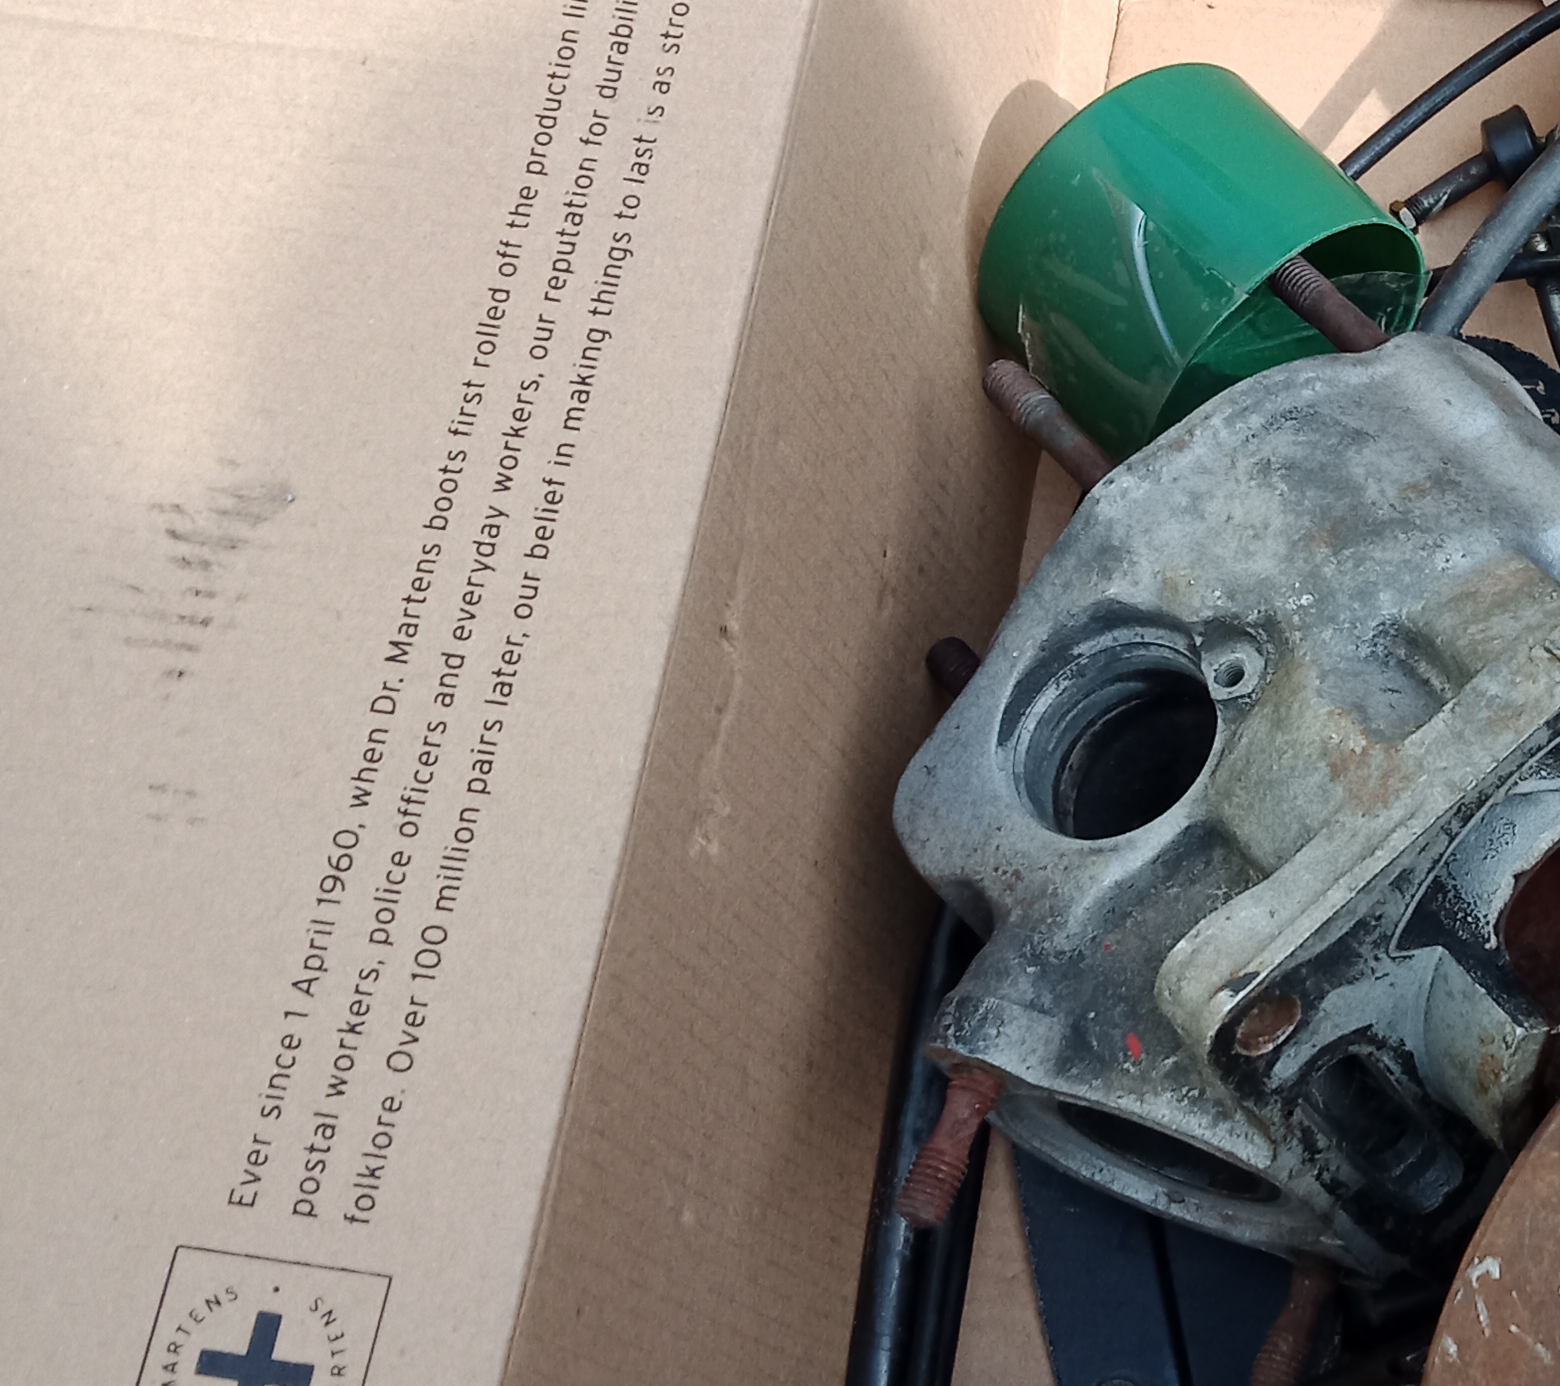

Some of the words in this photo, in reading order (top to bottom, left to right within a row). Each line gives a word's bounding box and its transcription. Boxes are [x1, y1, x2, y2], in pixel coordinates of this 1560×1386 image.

[524, 28, 581, 177] production
[636, 104, 666, 125] is
[651, 65, 676, 96] as
[578, 108, 611, 147] for
[621, 133, 658, 185] last
[504, 185, 540, 230] the
[542, 157, 599, 304] reputation
[612, 193, 642, 221] to
[495, 238, 524, 278] off
[586, 231, 635, 318] things
[472, 286, 512, 369] rolled
[528, 312, 557, 361] our
[446, 378, 487, 438] first
[561, 327, 613, 433] making
[491, 372, 546, 494] workers,
[546, 442, 577, 468] in
[421, 449, 468, 532] boots
[522, 476, 567, 561] belief
[383, 542, 442, 665] Martens
[451, 504, 511, 643] everyday
[512, 570, 542, 621] our
[368, 677, 405, 716] Dr.
[433, 651, 467, 709] and
[483, 632, 531, 707] later,
[348, 727, 391, 809] when
[396, 720, 448, 839] officers
[465, 718, 504, 796] pairs
[315, 823, 368, 908] 1960,
[367, 850, 413, 948] police
[434, 806, 482, 913] million
[290, 918, 336, 999] April
[409, 924, 449, 982] 100
[282, 1009, 311, 1022] 1
[324, 959, 387, 1099] workers,
[385, 993, 429, 1074] Over
[257, 1032, 303, 1121] since
[226, 1132, 273, 1209] Ever
[291, 1110, 340, 1220] postal
[342, 1089, 407, 1226] folklore.
